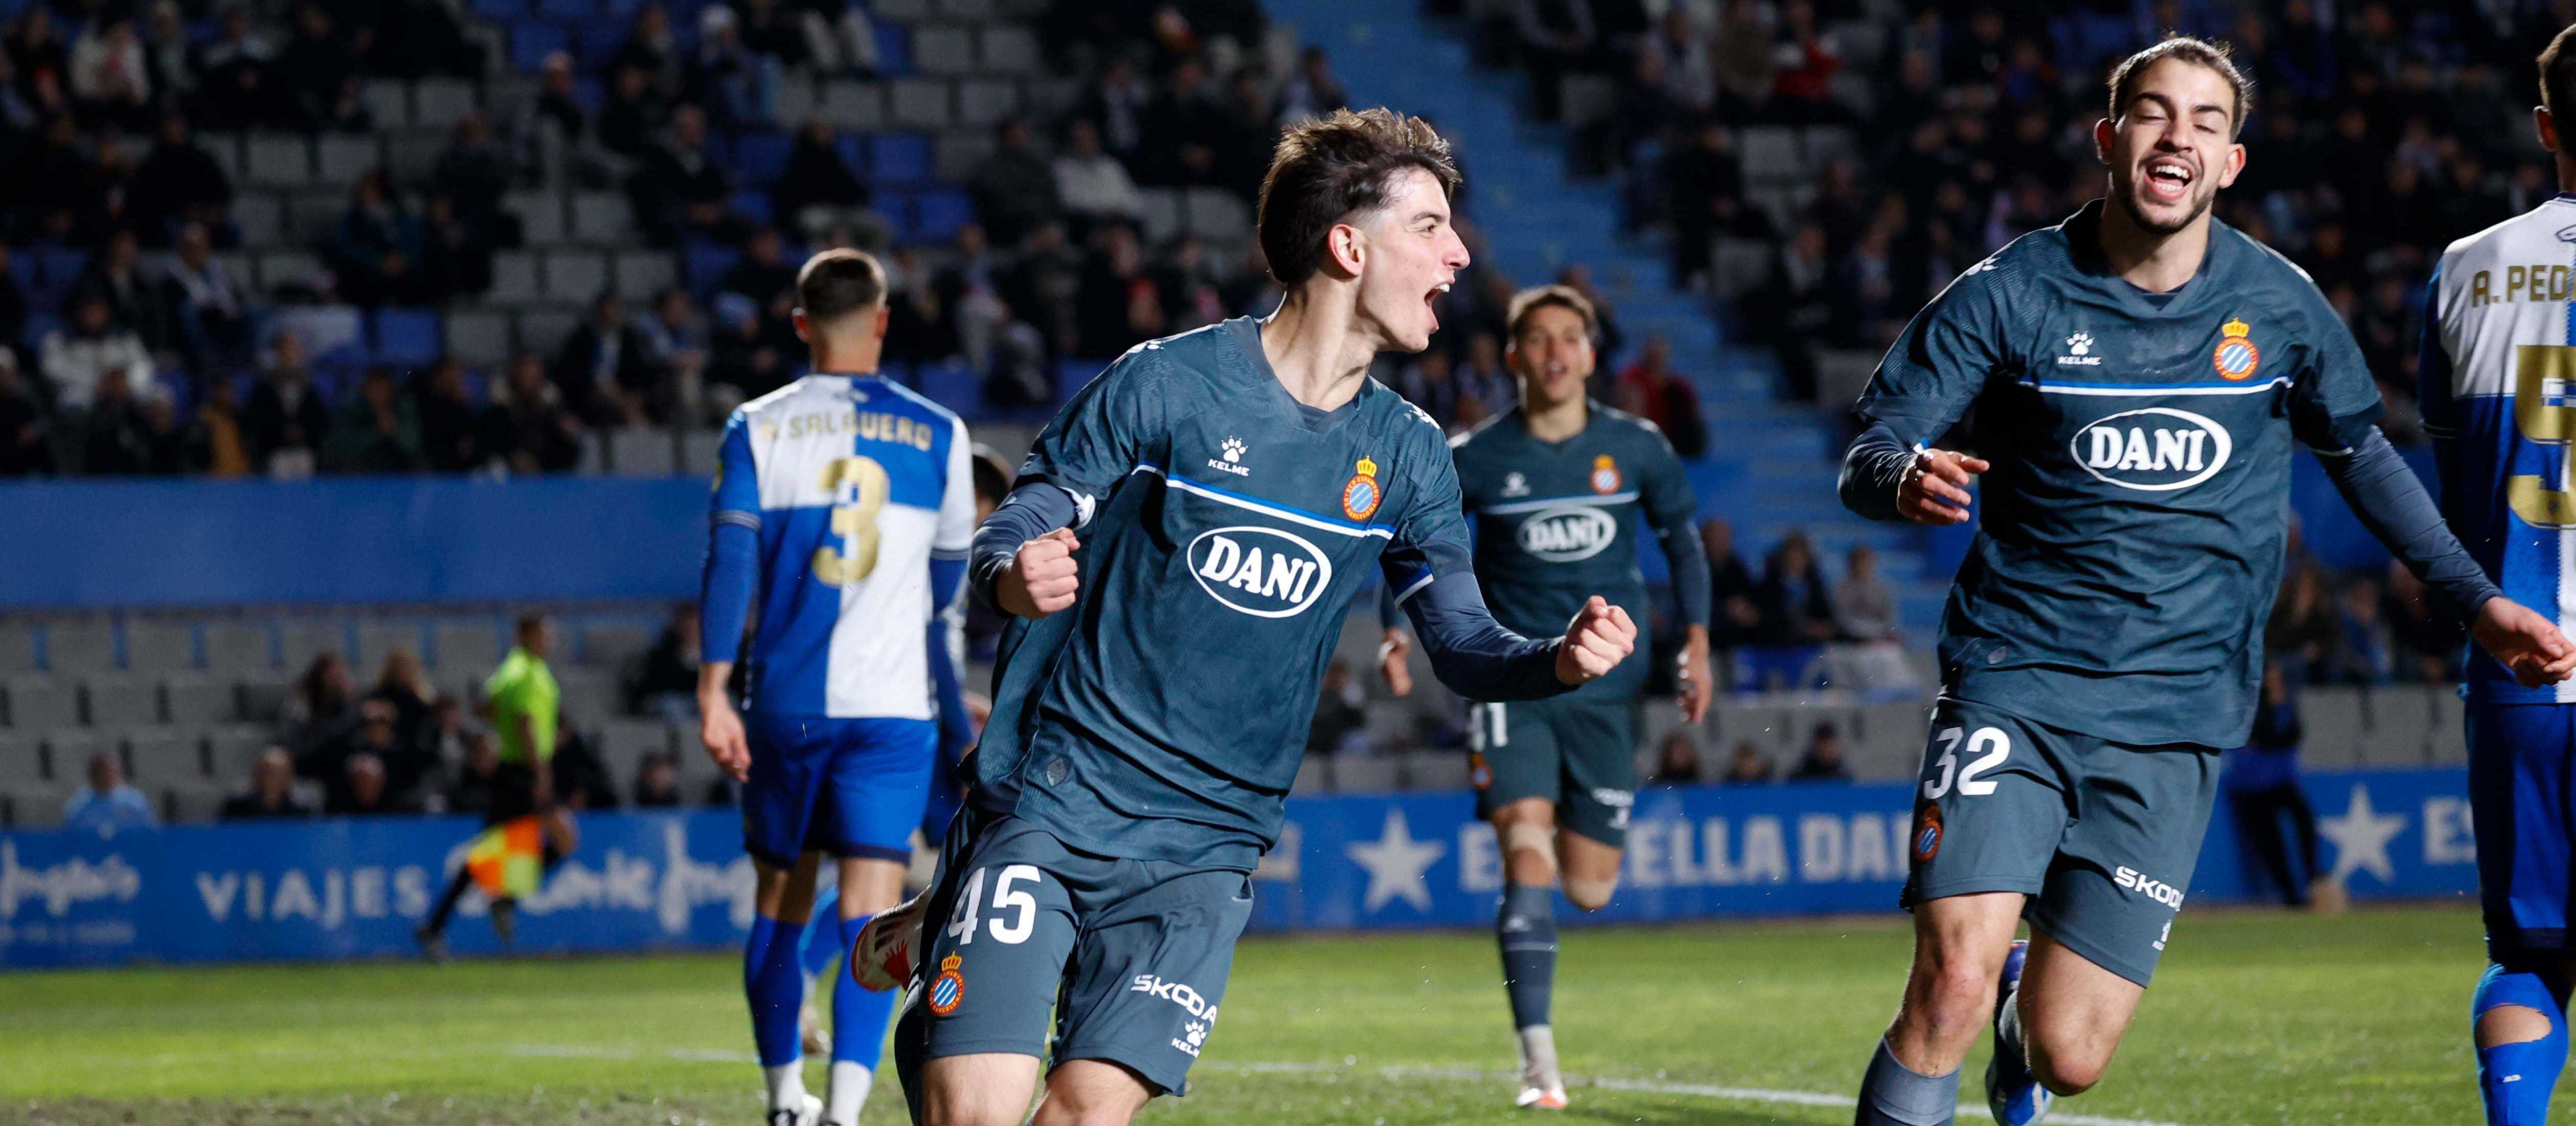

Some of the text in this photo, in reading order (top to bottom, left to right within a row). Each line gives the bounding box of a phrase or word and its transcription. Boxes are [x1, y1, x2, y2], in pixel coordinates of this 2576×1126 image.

[2506, 265, 2576, 302] PED
[2058, 356, 2101, 366] KELME
[1208, 458, 1250, 477] KELME
[2088, 426, 2207, 471] DANI
[2507, 345, 2576, 530] 5
[813, 455, 891, 585] 3
[1529, 517, 1599, 552] DANI
[1200, 535, 1316, 603] DANI
[1924, 727, 2011, 799] 32
[1460, 816, 1789, 889] EELLA
[197, 865, 430, 930] VIAJES
[948, 865, 1041, 945] 45
[1130, 974, 1217, 1028] SKODA
